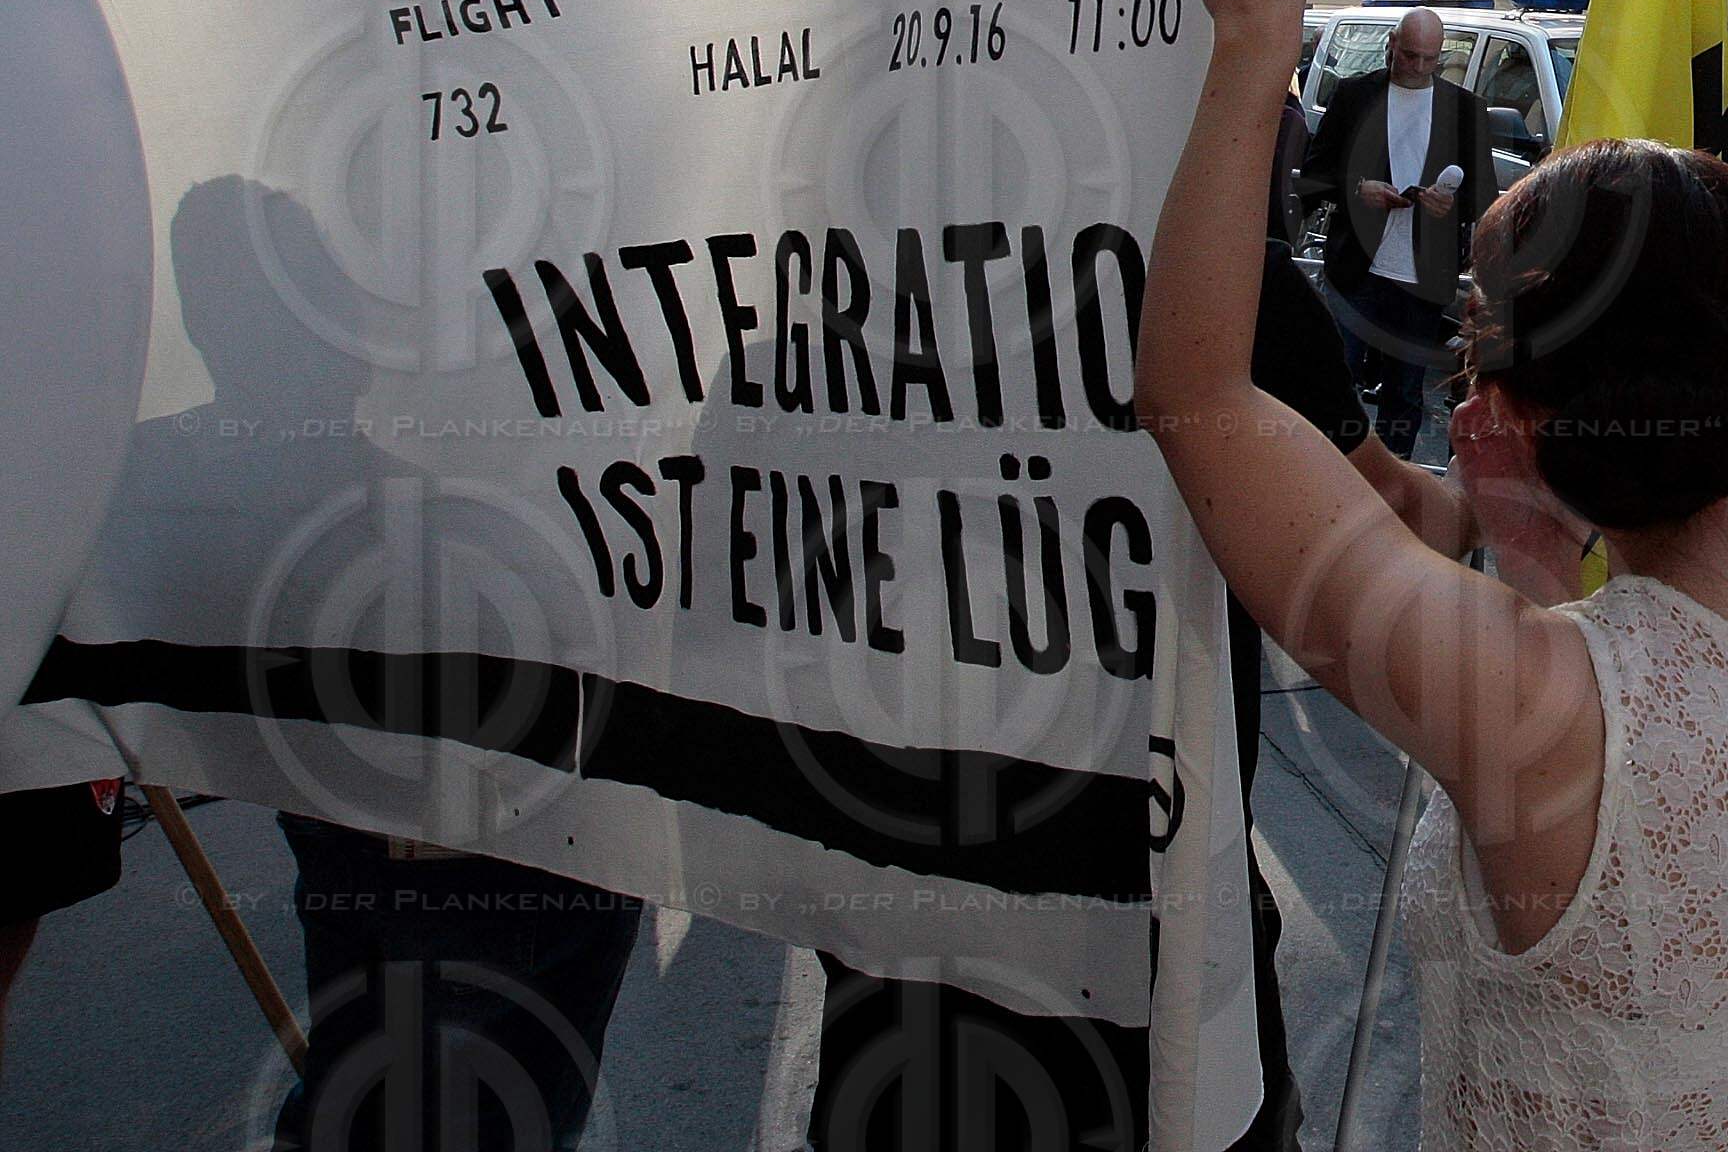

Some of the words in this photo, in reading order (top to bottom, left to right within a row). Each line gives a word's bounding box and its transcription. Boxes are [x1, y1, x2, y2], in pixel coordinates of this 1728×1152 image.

[421, 82, 508, 141] 732
[690, 26, 821, 96] HALAL
[890, 2, 1006, 73] 20.9.16
[483, 222, 1152, 433] INTEGRATIO
[556, 455, 706, 610] IST
[729, 466, 904, 654] EINE
[937, 454, 1156, 680] LÜG
